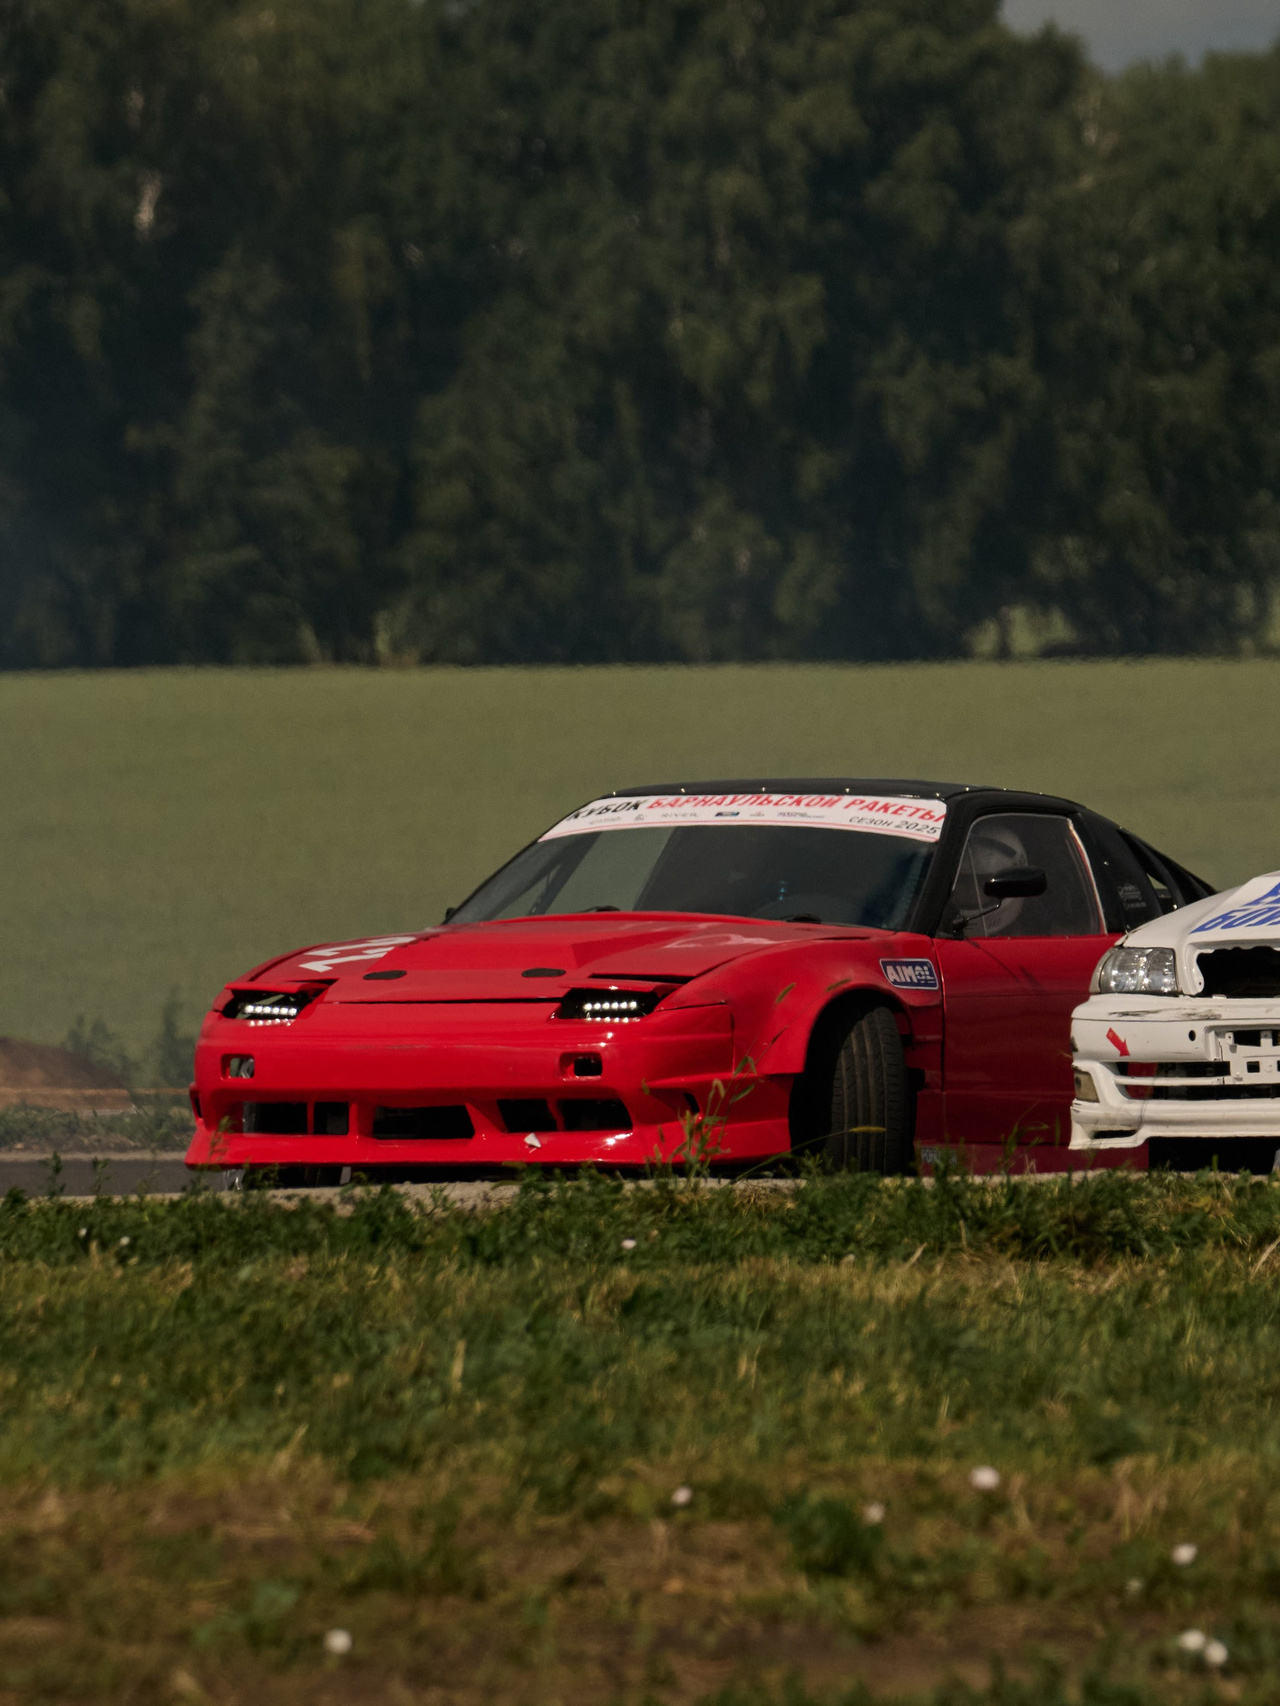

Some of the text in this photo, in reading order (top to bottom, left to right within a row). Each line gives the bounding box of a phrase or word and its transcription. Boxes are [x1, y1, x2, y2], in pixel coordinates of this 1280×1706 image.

[566, 794, 947, 823] КУБОК БАРНАУЛЬСКОЙ РАКЕТЫ
[849, 816, 942, 835] СЕЗОН 2025
[886, 965, 937, 984] AIMOL
